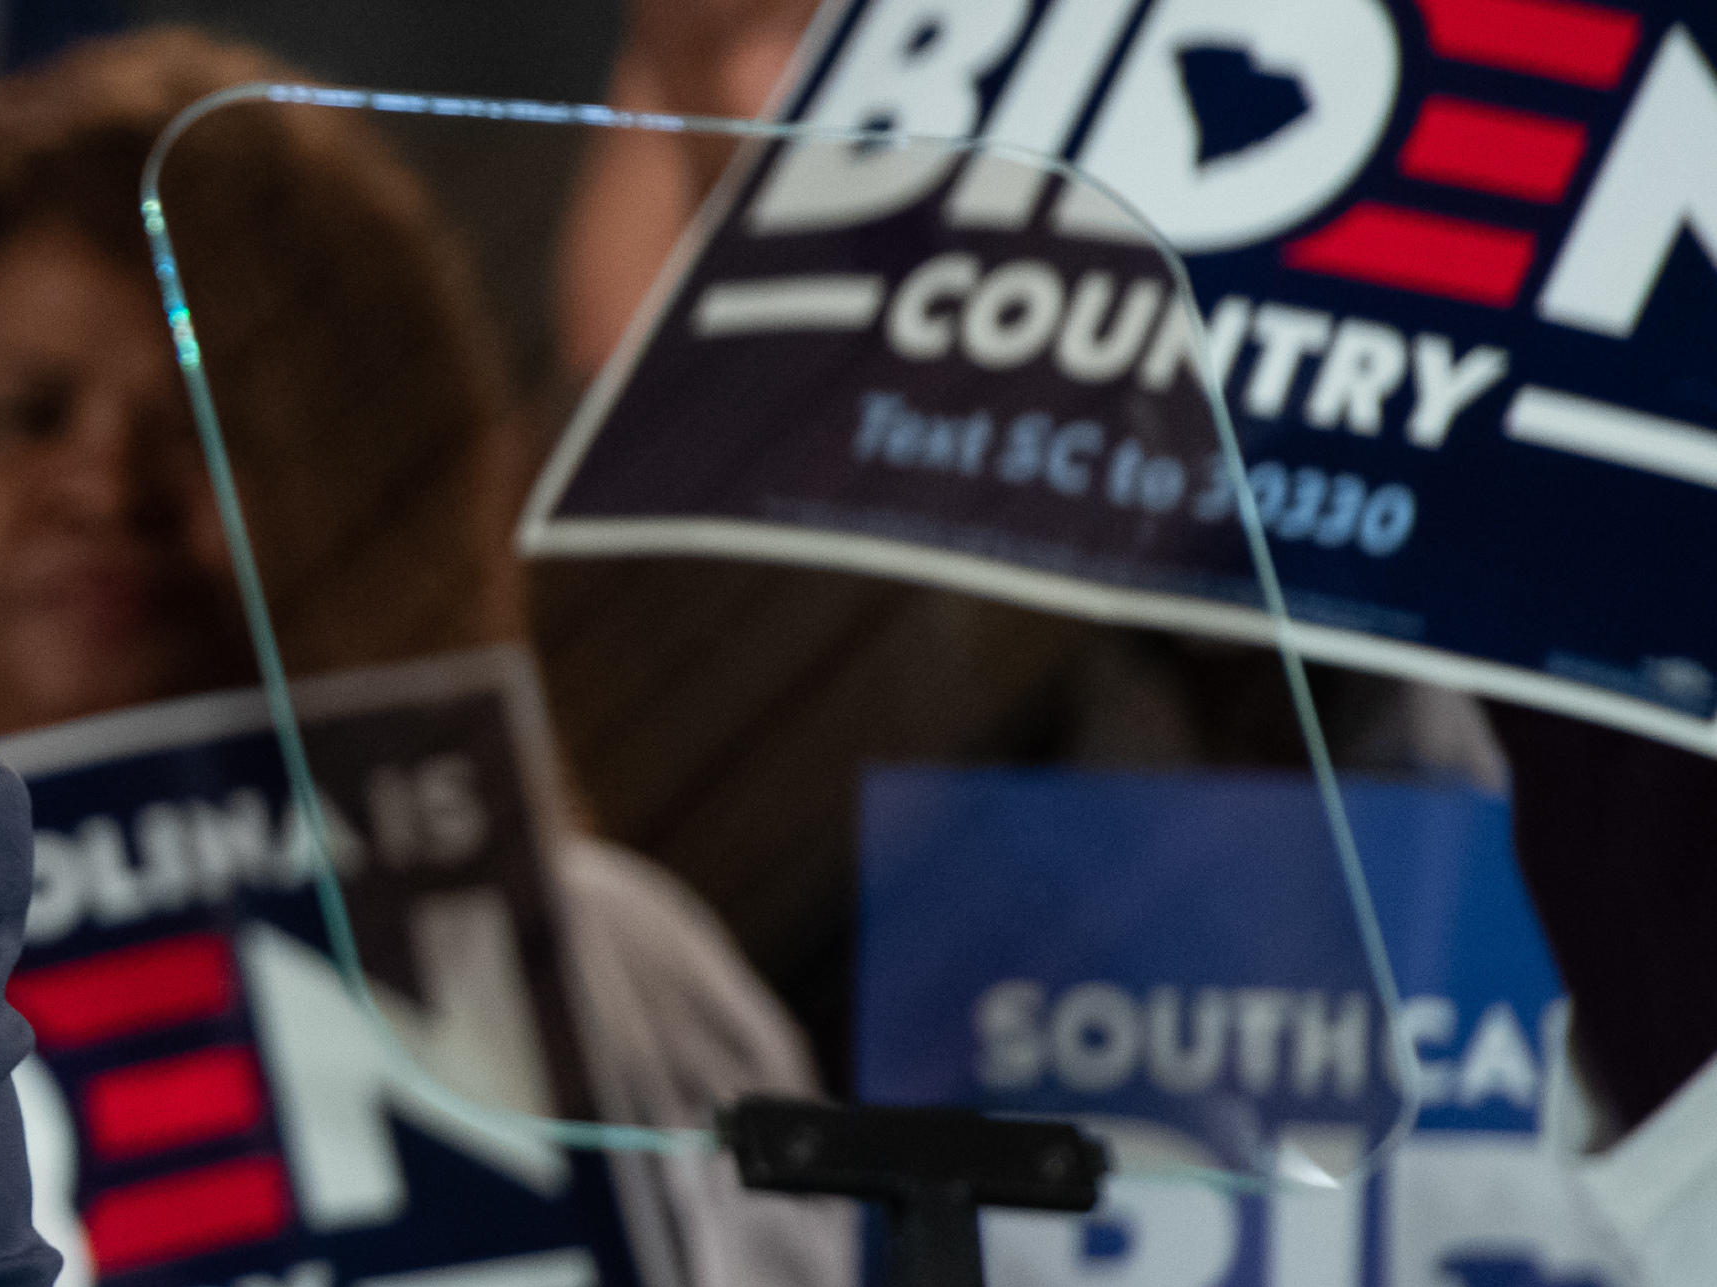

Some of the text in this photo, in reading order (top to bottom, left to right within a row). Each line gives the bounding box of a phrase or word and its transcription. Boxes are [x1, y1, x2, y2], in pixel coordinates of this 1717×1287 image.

[886, 253, 1512, 449] COUNTRY
[854, 390, 994, 478] Text
[996, 411, 1108, 499] SC
[1106, 438, 1188, 513] to
[974, 977, 1368, 1102] SOUTH
